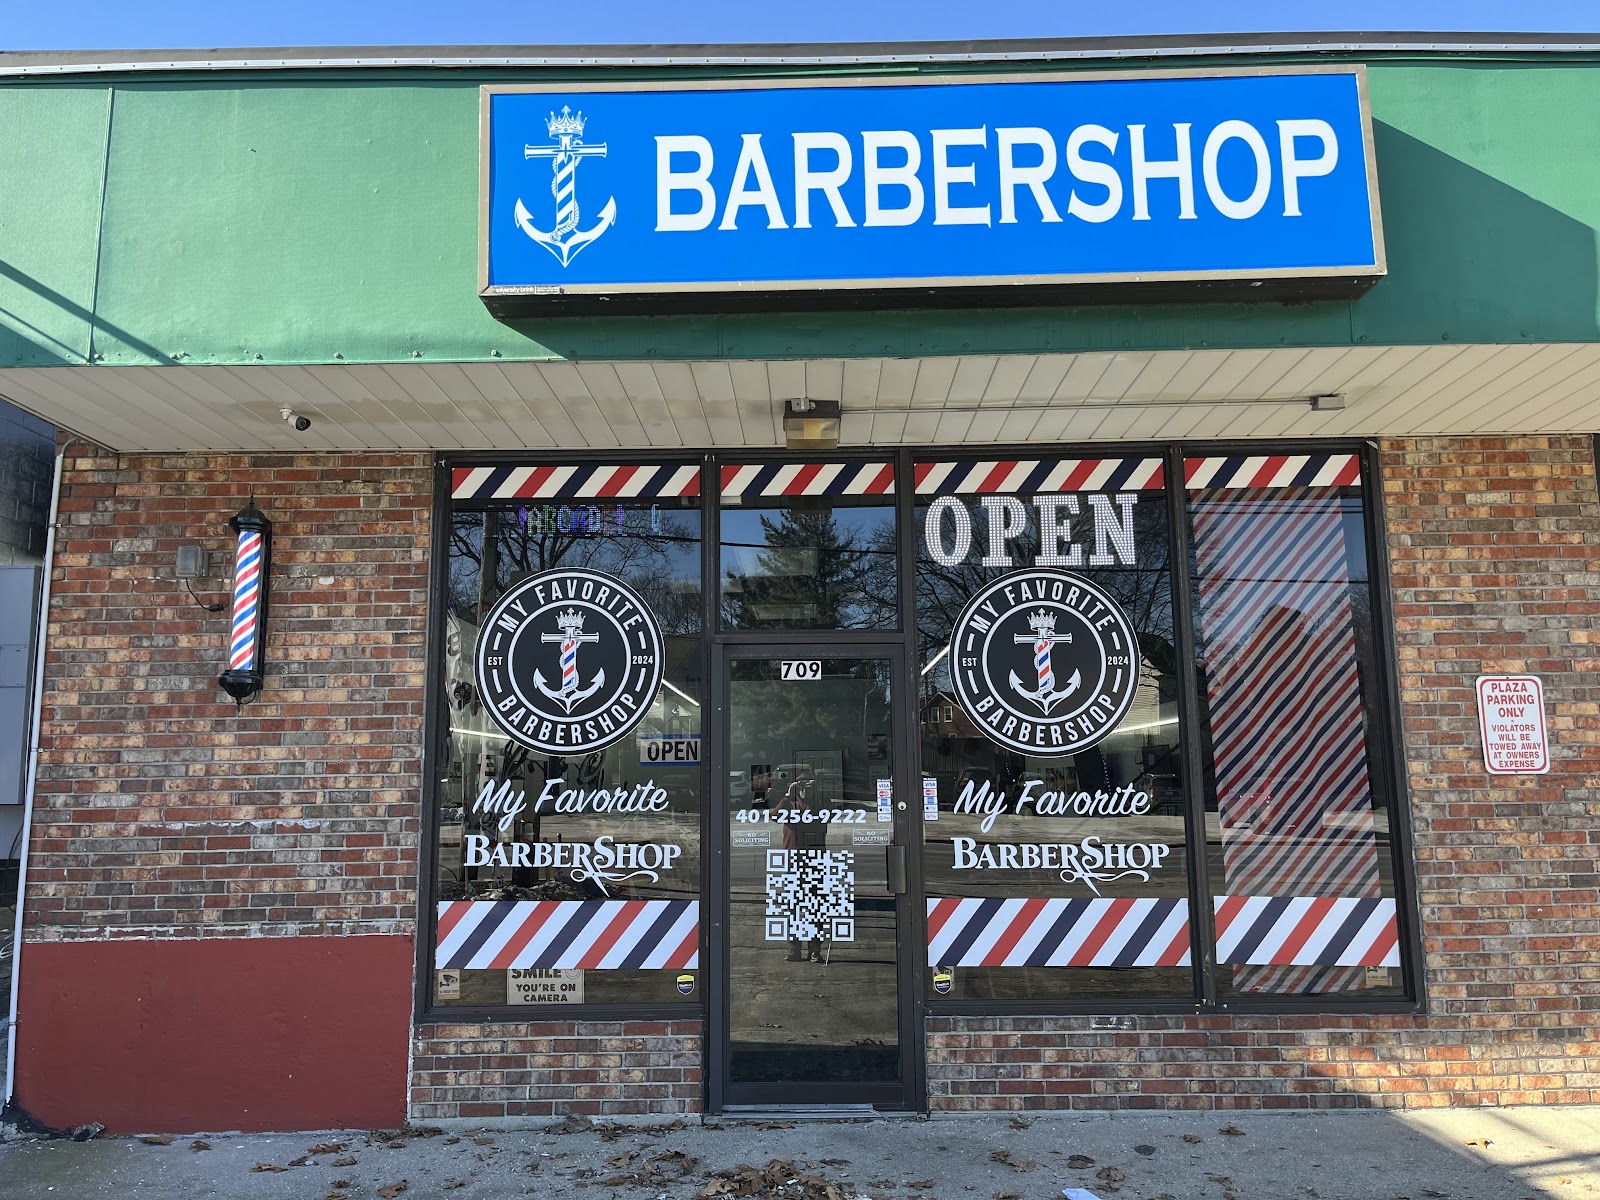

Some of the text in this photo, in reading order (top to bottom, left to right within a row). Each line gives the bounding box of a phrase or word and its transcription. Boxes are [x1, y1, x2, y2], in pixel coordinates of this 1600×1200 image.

[654, 119, 1339, 232] BARBERSHOP
[924, 493, 1138, 567] OPEN
[497, 579, 643, 633] MY FAVORITE
[969, 579, 1115, 634] MY FAVORITE
[487, 656, 502, 666] EST
[632, 655, 654, 665] 2024
[962, 657, 977, 667] EST
[1107, 656, 1129, 666] 2024
[782, 662, 820, 678] 709
[1491, 683, 1528, 693] PLAZA
[1487, 694, 1535, 705] PARKING
[1498, 707, 1525, 717] ONLY
[497, 692, 638, 745] BARBERSHOP
[976, 693, 1116, 746] BARBERSHOP
[1491, 724, 1536, 732] VIOLATORS
[647, 740, 698, 761] OPEN
[1489, 742, 1541, 751] TOWED AWAY
[1493, 751, 1540, 759] AT OWNERS
[1499, 760, 1535, 768] EXPENSE
[472, 778, 669, 832] My Favorite
[953, 779, 1151, 834] My Favorite
[735, 809, 867, 824] 401-256-9222
[511, 968, 561, 979] SMILE
[516, 983, 576, 992] YOU'RE ON
[523, 994, 568, 1002] CAMERA
